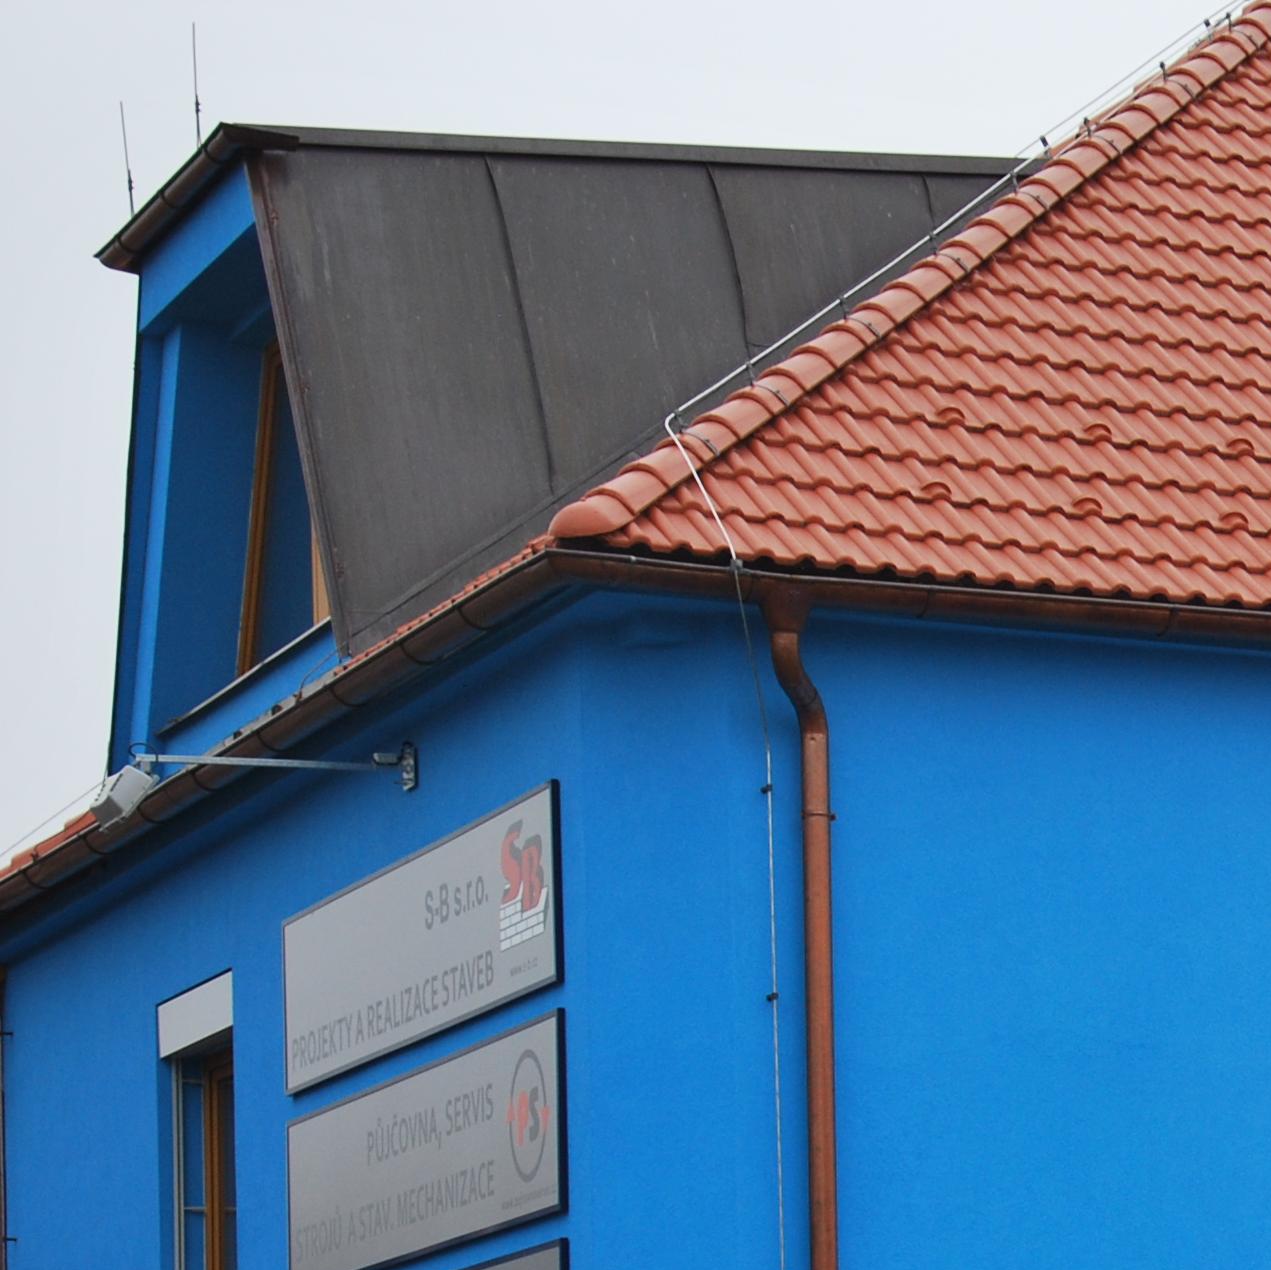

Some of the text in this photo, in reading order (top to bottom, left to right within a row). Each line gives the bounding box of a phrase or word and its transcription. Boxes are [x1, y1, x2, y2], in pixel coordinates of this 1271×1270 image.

[424, 874, 489, 931] S-B s.r.o.
[501, 818, 545, 913] SB
[291, 949, 495, 1071] PROJEKTY A REALIZACE STAVEB
[367, 1083, 494, 1166] PŮJČOVNA, SERVIS
[517, 1086, 539, 1147] PS
[295, 1207, 342, 1263] STROJŮ
[347, 1215, 359, 1243] A
[358, 1200, 394, 1241] STAV.
[397, 1159, 495, 1227] MECHANIZACE
